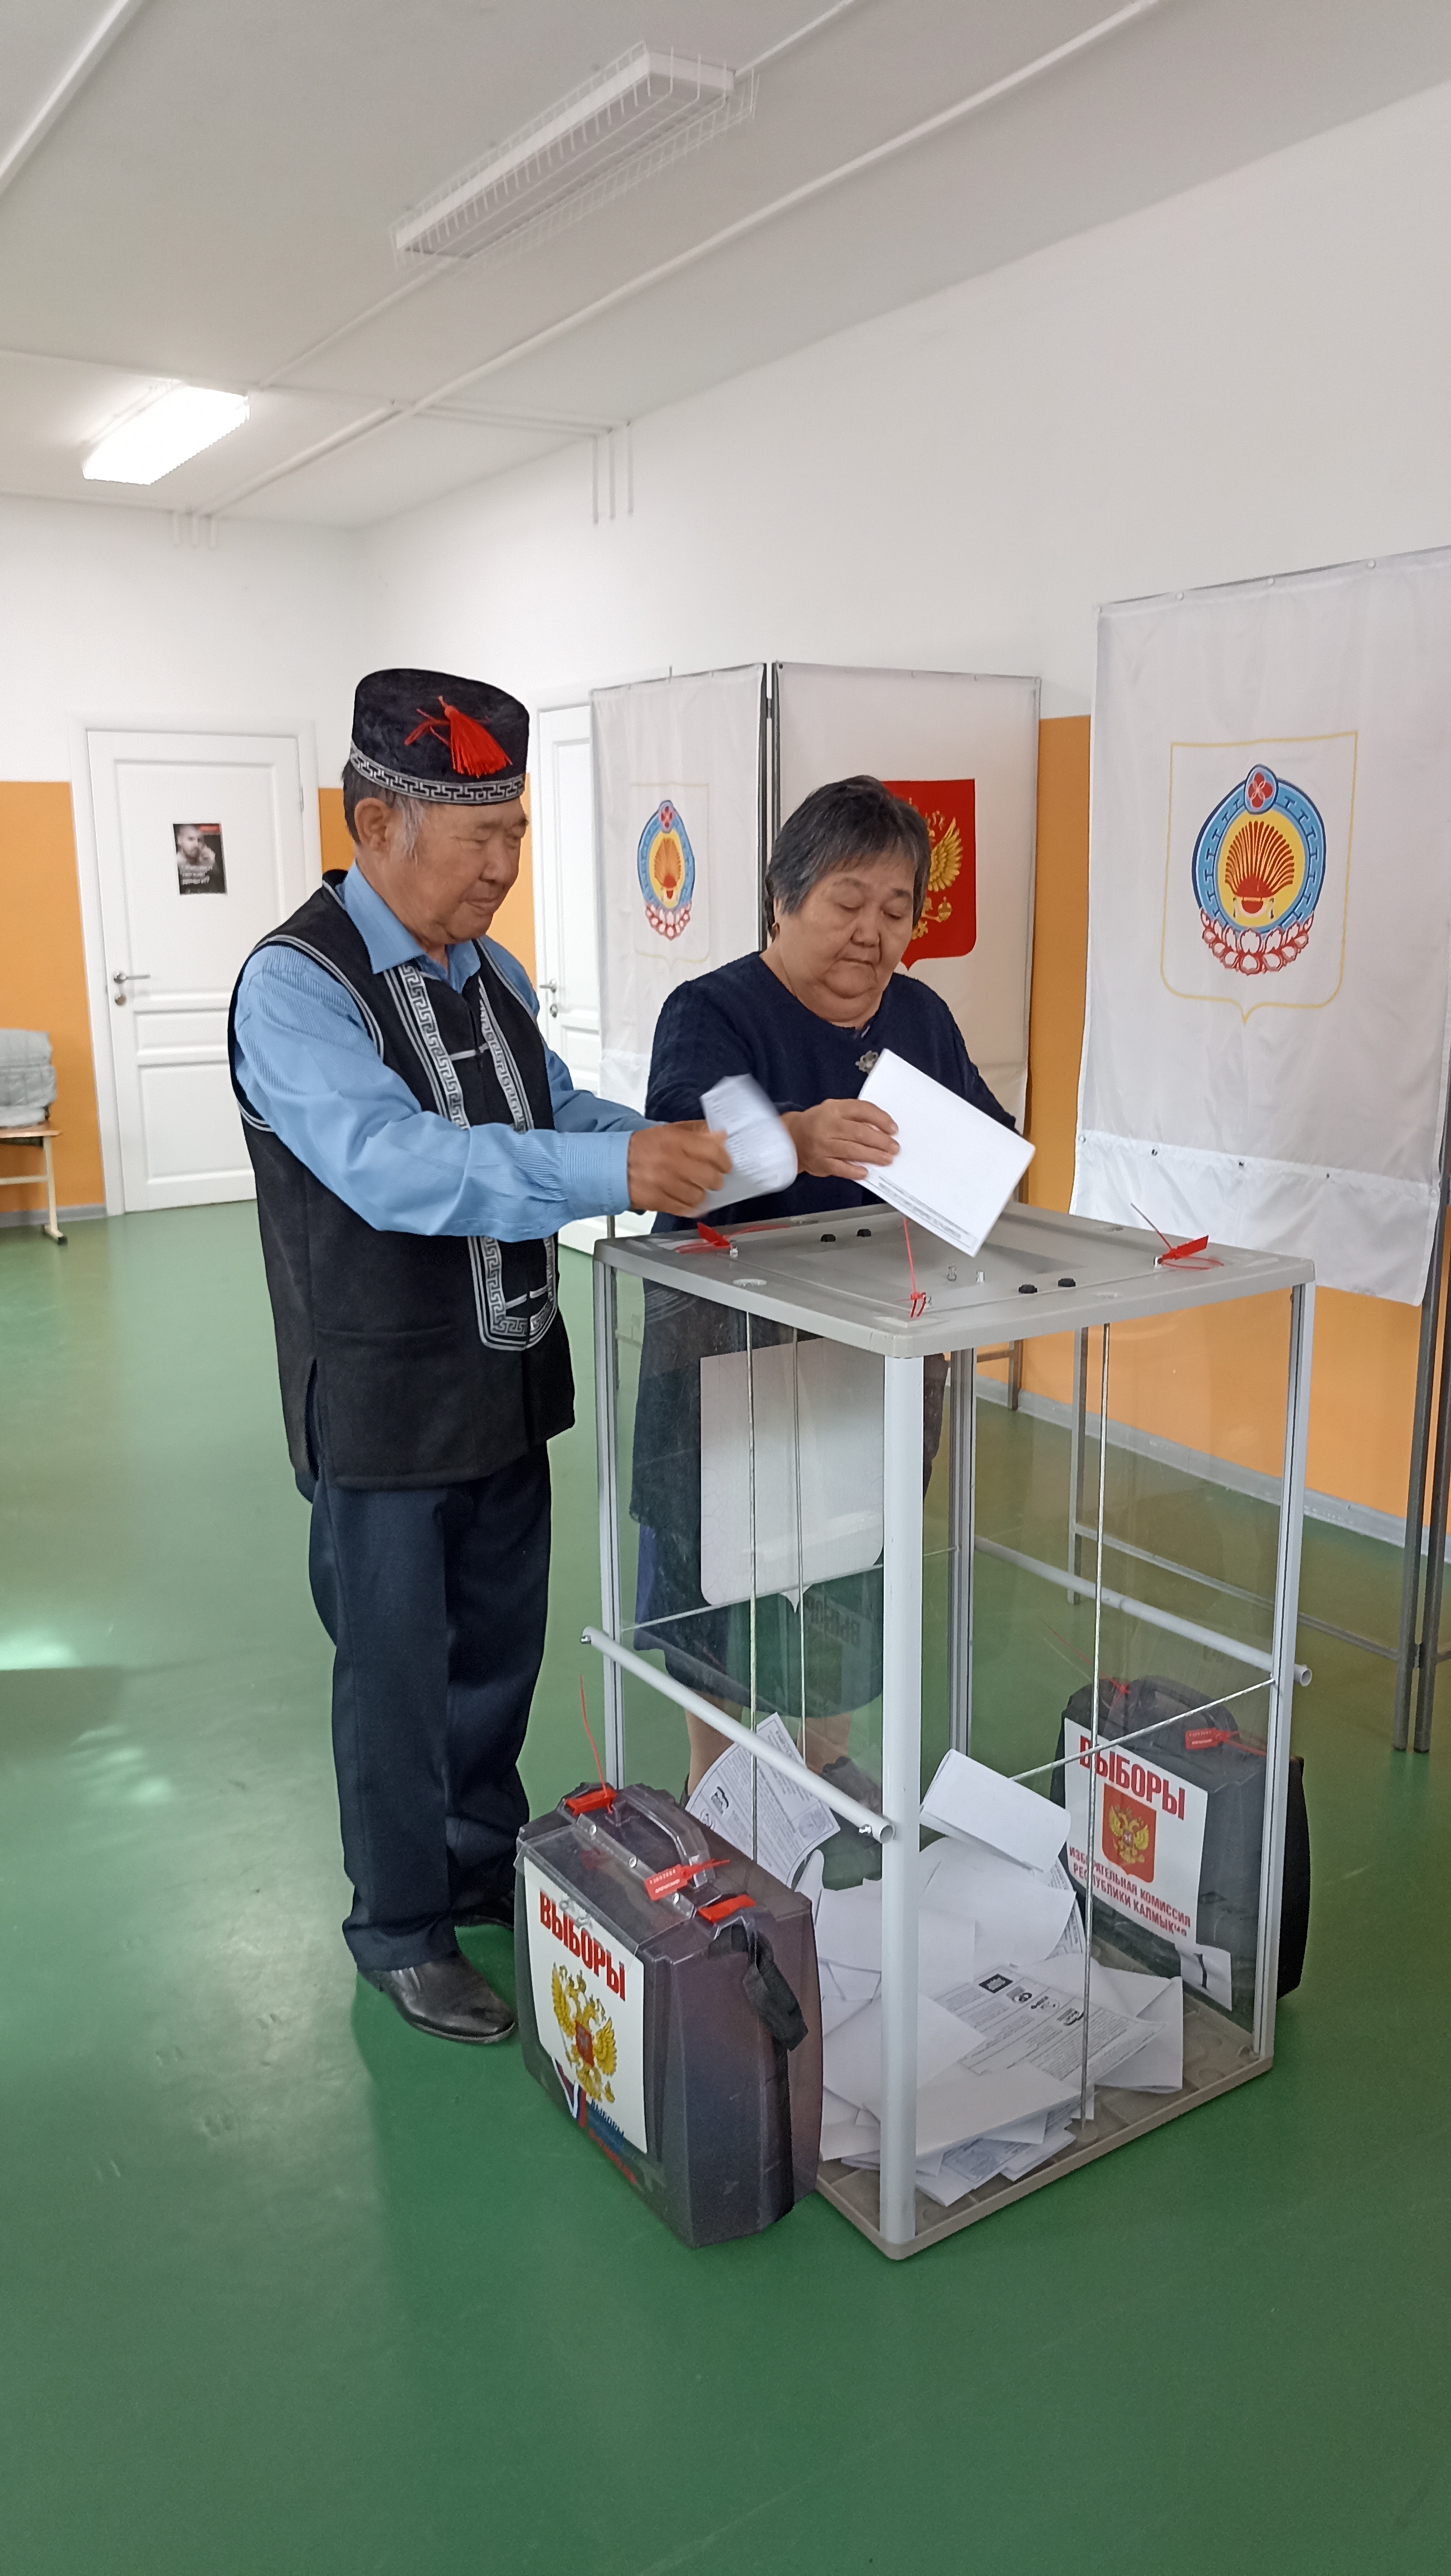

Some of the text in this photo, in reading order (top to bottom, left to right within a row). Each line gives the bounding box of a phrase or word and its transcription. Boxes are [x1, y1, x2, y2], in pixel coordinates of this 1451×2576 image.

[1079, 1735, 1185, 1820] ВЫБОРЫ
[1069, 1846, 1137, 1895] ИЗБАТЕЛЬНАЯ
[1140, 1887, 1191, 1928] КОМИССИЯ
[539, 1888, 626, 2002] ВЫБОРЫ
